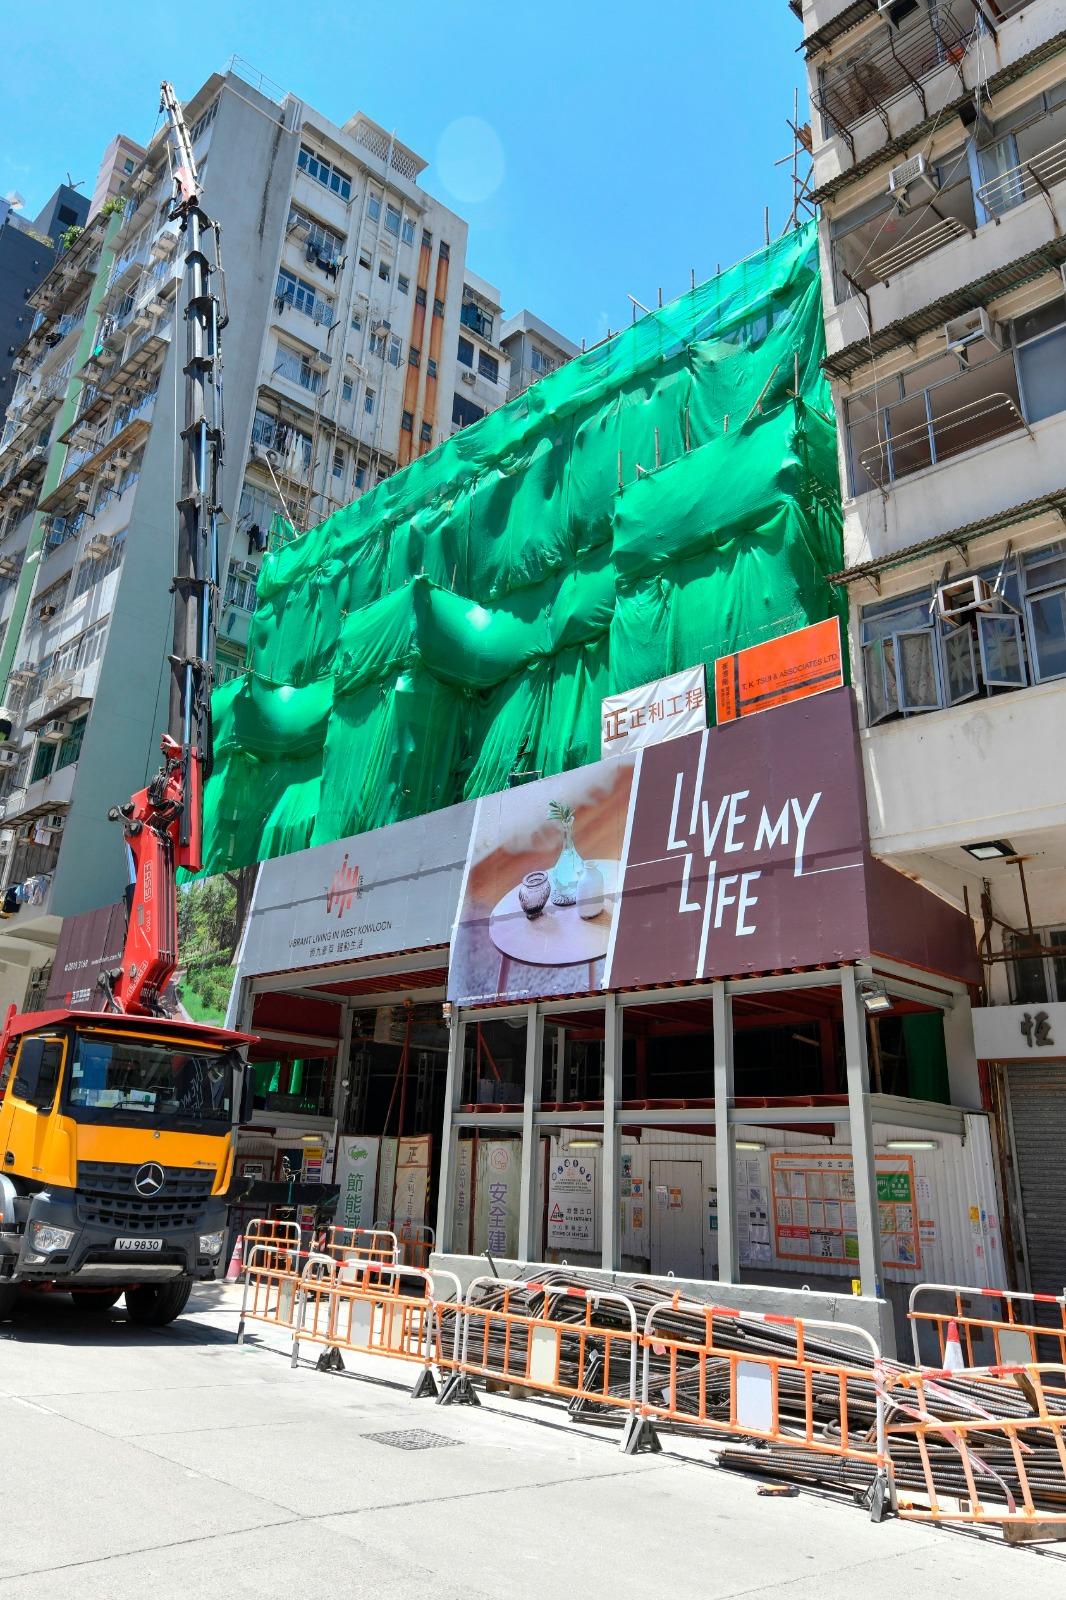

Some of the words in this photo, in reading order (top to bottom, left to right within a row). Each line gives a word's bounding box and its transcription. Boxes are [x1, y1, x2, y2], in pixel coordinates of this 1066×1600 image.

[779, 658, 823, 678] ASSOCIATES
[666, 772, 750, 858] LIVE
[754, 791, 822, 877] MY
[143, 860, 153, 902] FASSI
[678, 854, 762, 937] LIFE
[289, 937, 311, 948] VIBRANT
[312, 932, 332, 944] LIVING
[332, 930, 340, 940] IN
[340, 926, 357, 938] WEST
[358, 921, 392, 935] KOWLOON
[488, 1181, 508, 1256] 安全建
[118, 1240, 133, 1250] VJ
[134, 1239, 159, 1250] 9830
